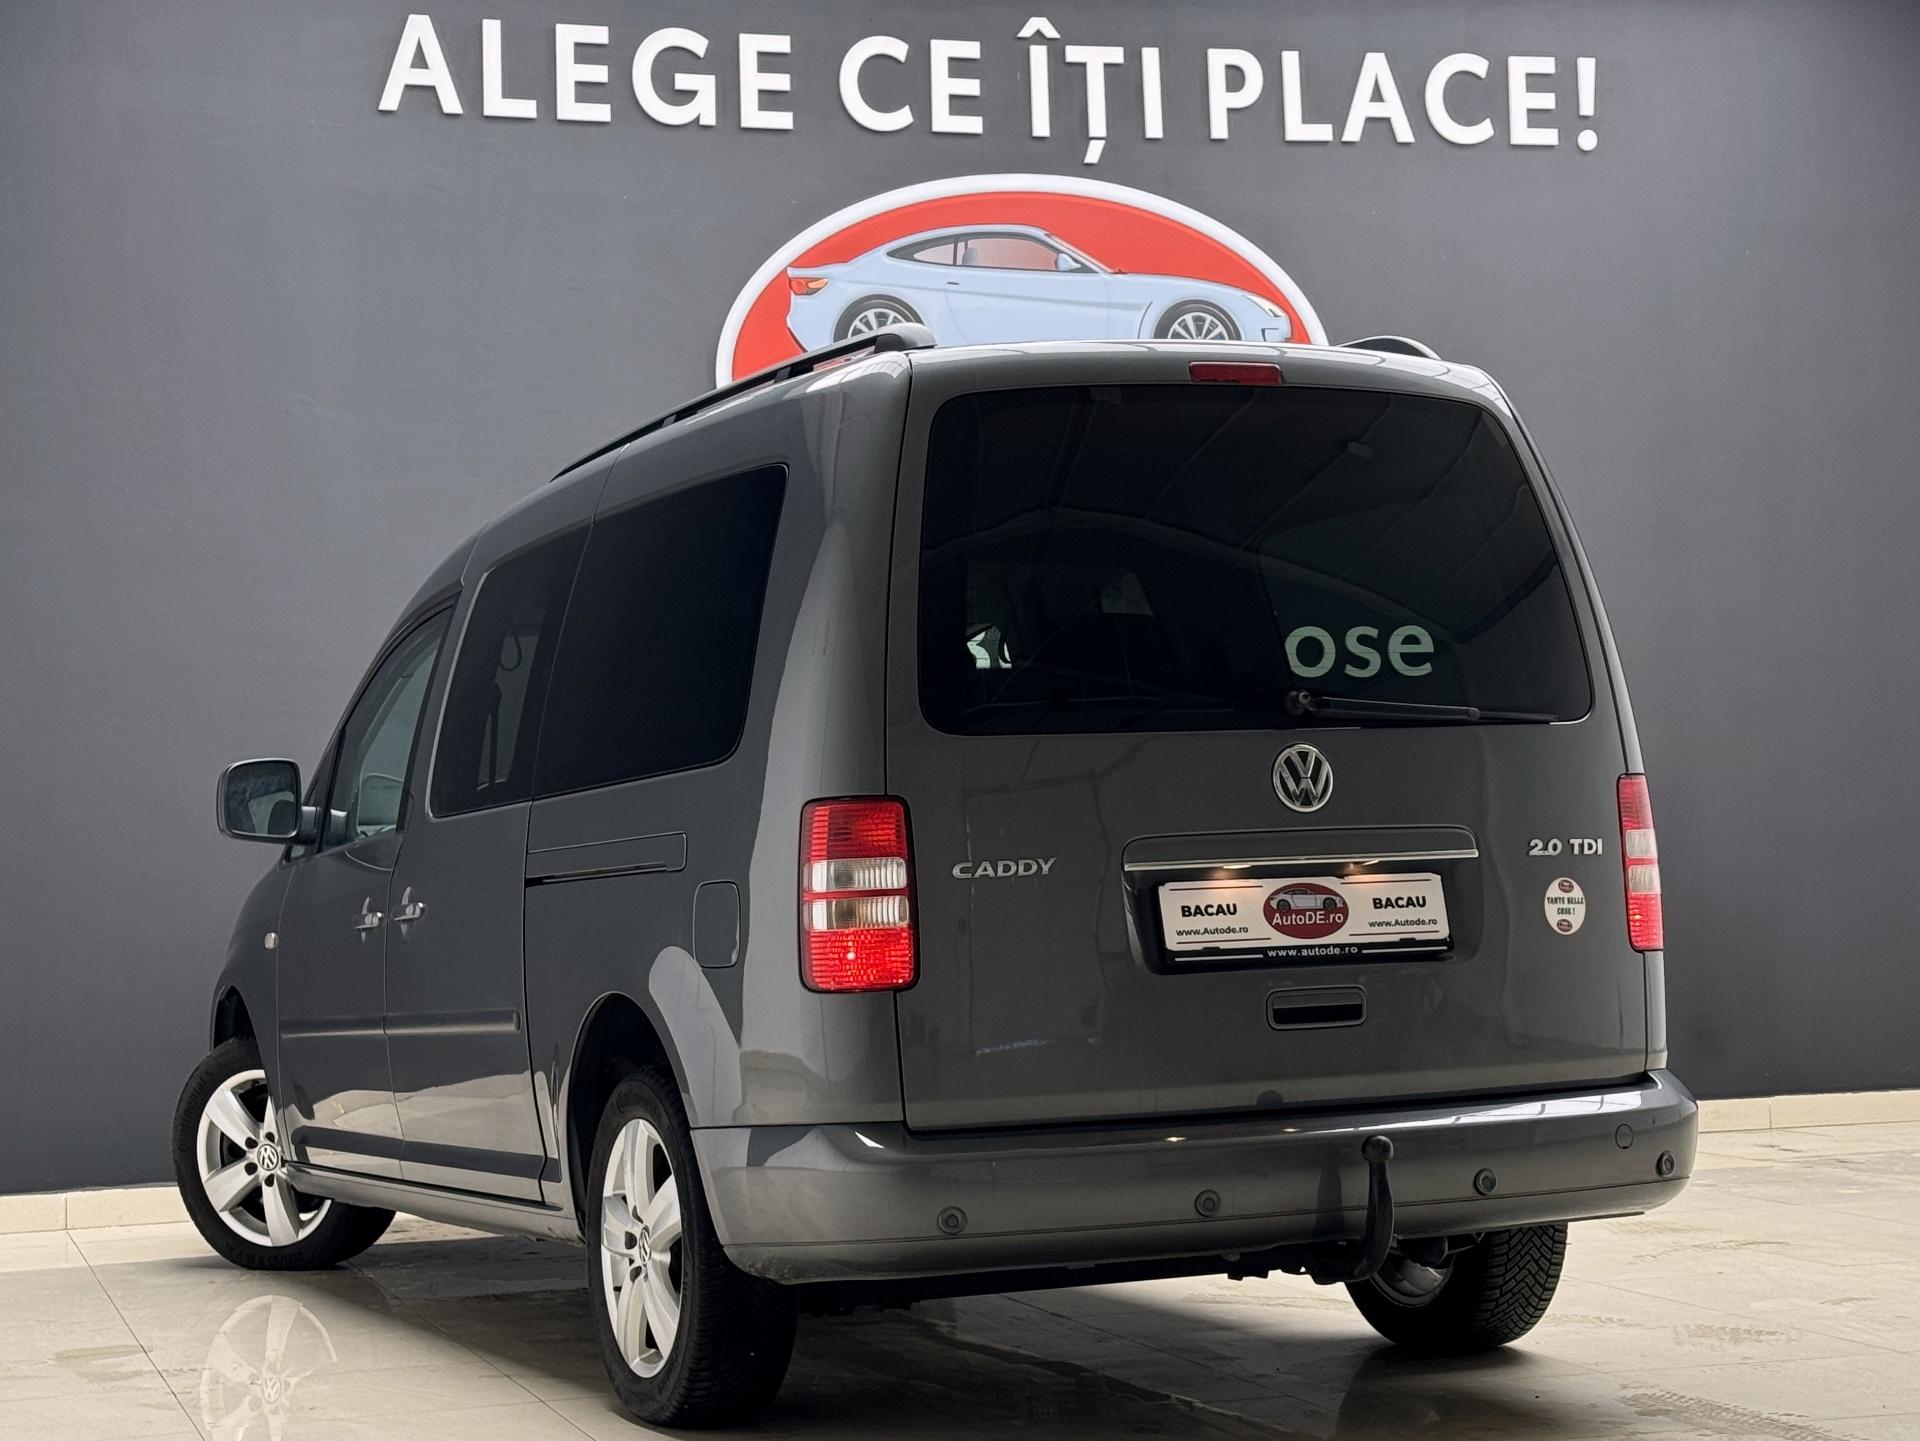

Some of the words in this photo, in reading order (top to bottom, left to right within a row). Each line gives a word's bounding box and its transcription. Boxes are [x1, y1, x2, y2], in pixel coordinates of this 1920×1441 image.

[378, 13, 794, 131] ALEGE
[838, 34, 984, 134] CE
[1207, 47, 1599, 152] PLACE!
[1569, 838, 1603, 855] TDI
[952, 857, 1056, 879] CADDY
[1372, 895, 1427, 910] BACAU
[1180, 903, 1238, 918] BACAU
[1271, 910, 1345, 927] AutoDE.ro
[1368, 917, 1438, 929] www.Autode.ro
[1175, 926, 1249, 937] www.Autode.ro
[1266, 945, 1359, 958] www.autode.ro
